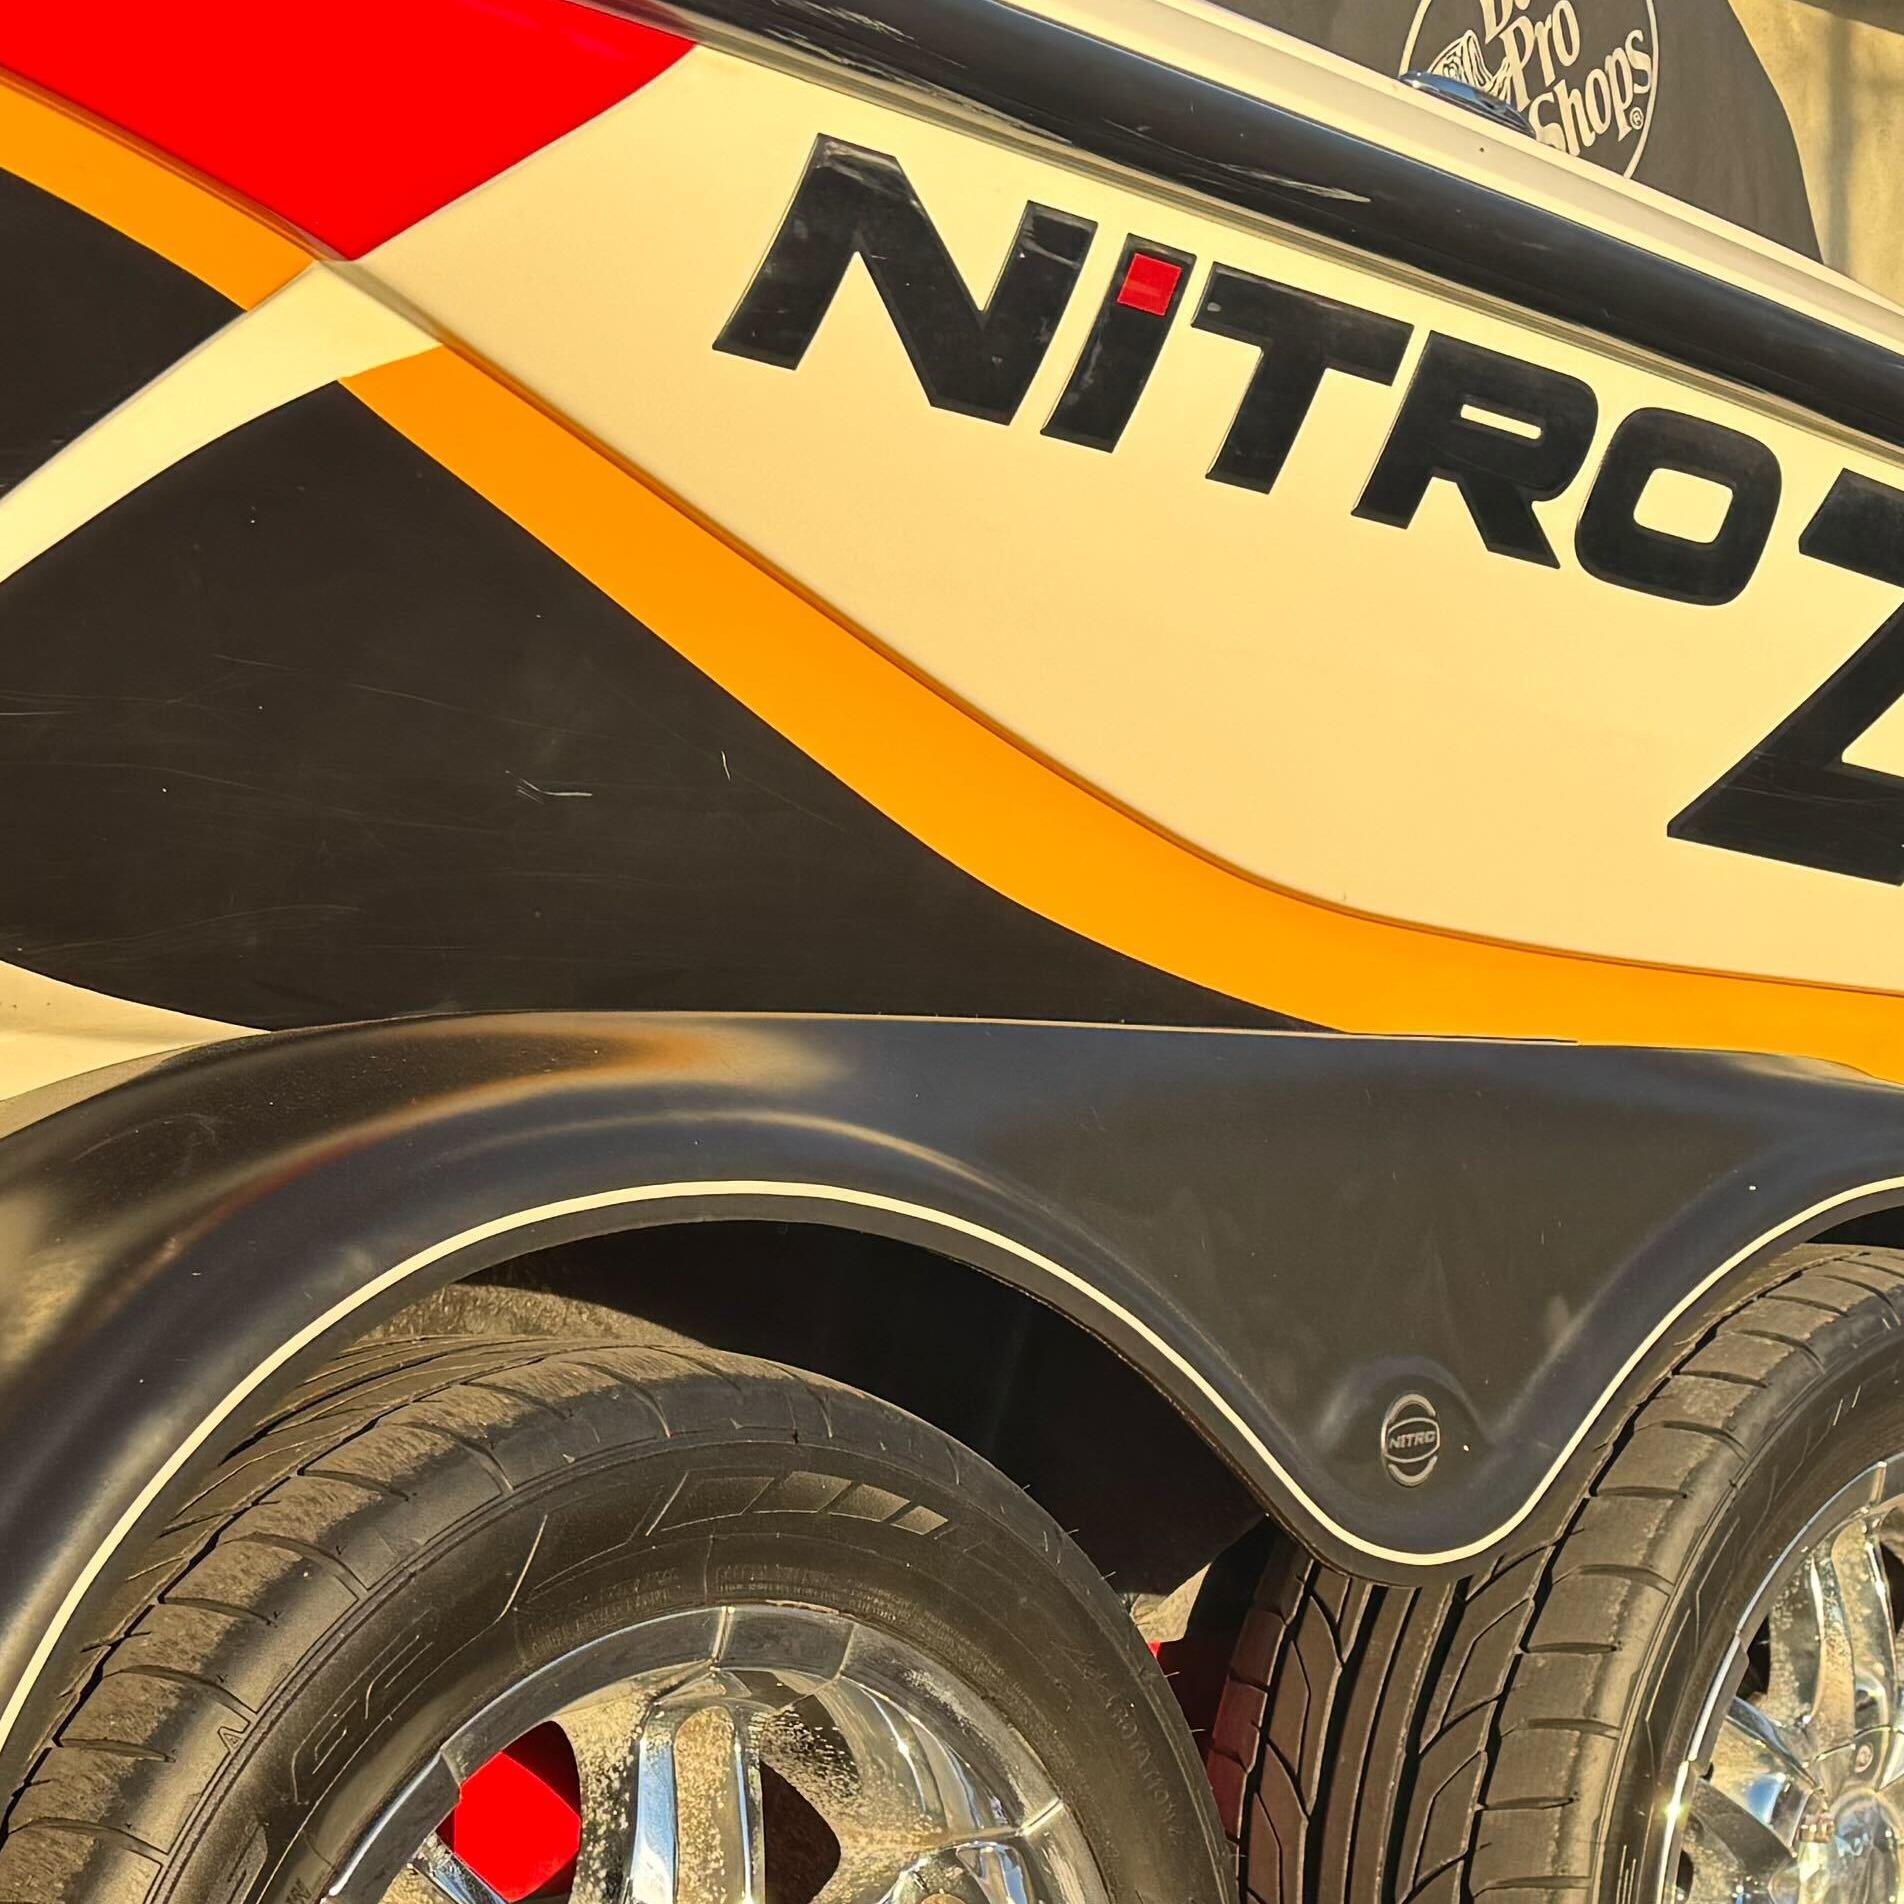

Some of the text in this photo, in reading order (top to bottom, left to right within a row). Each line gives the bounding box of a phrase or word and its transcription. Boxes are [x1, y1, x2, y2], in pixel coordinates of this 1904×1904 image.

[1499, 0, 1580, 112] Pro
[1528, 29, 1652, 157] Shops
[714, 134, 1781, 605] NITRO
